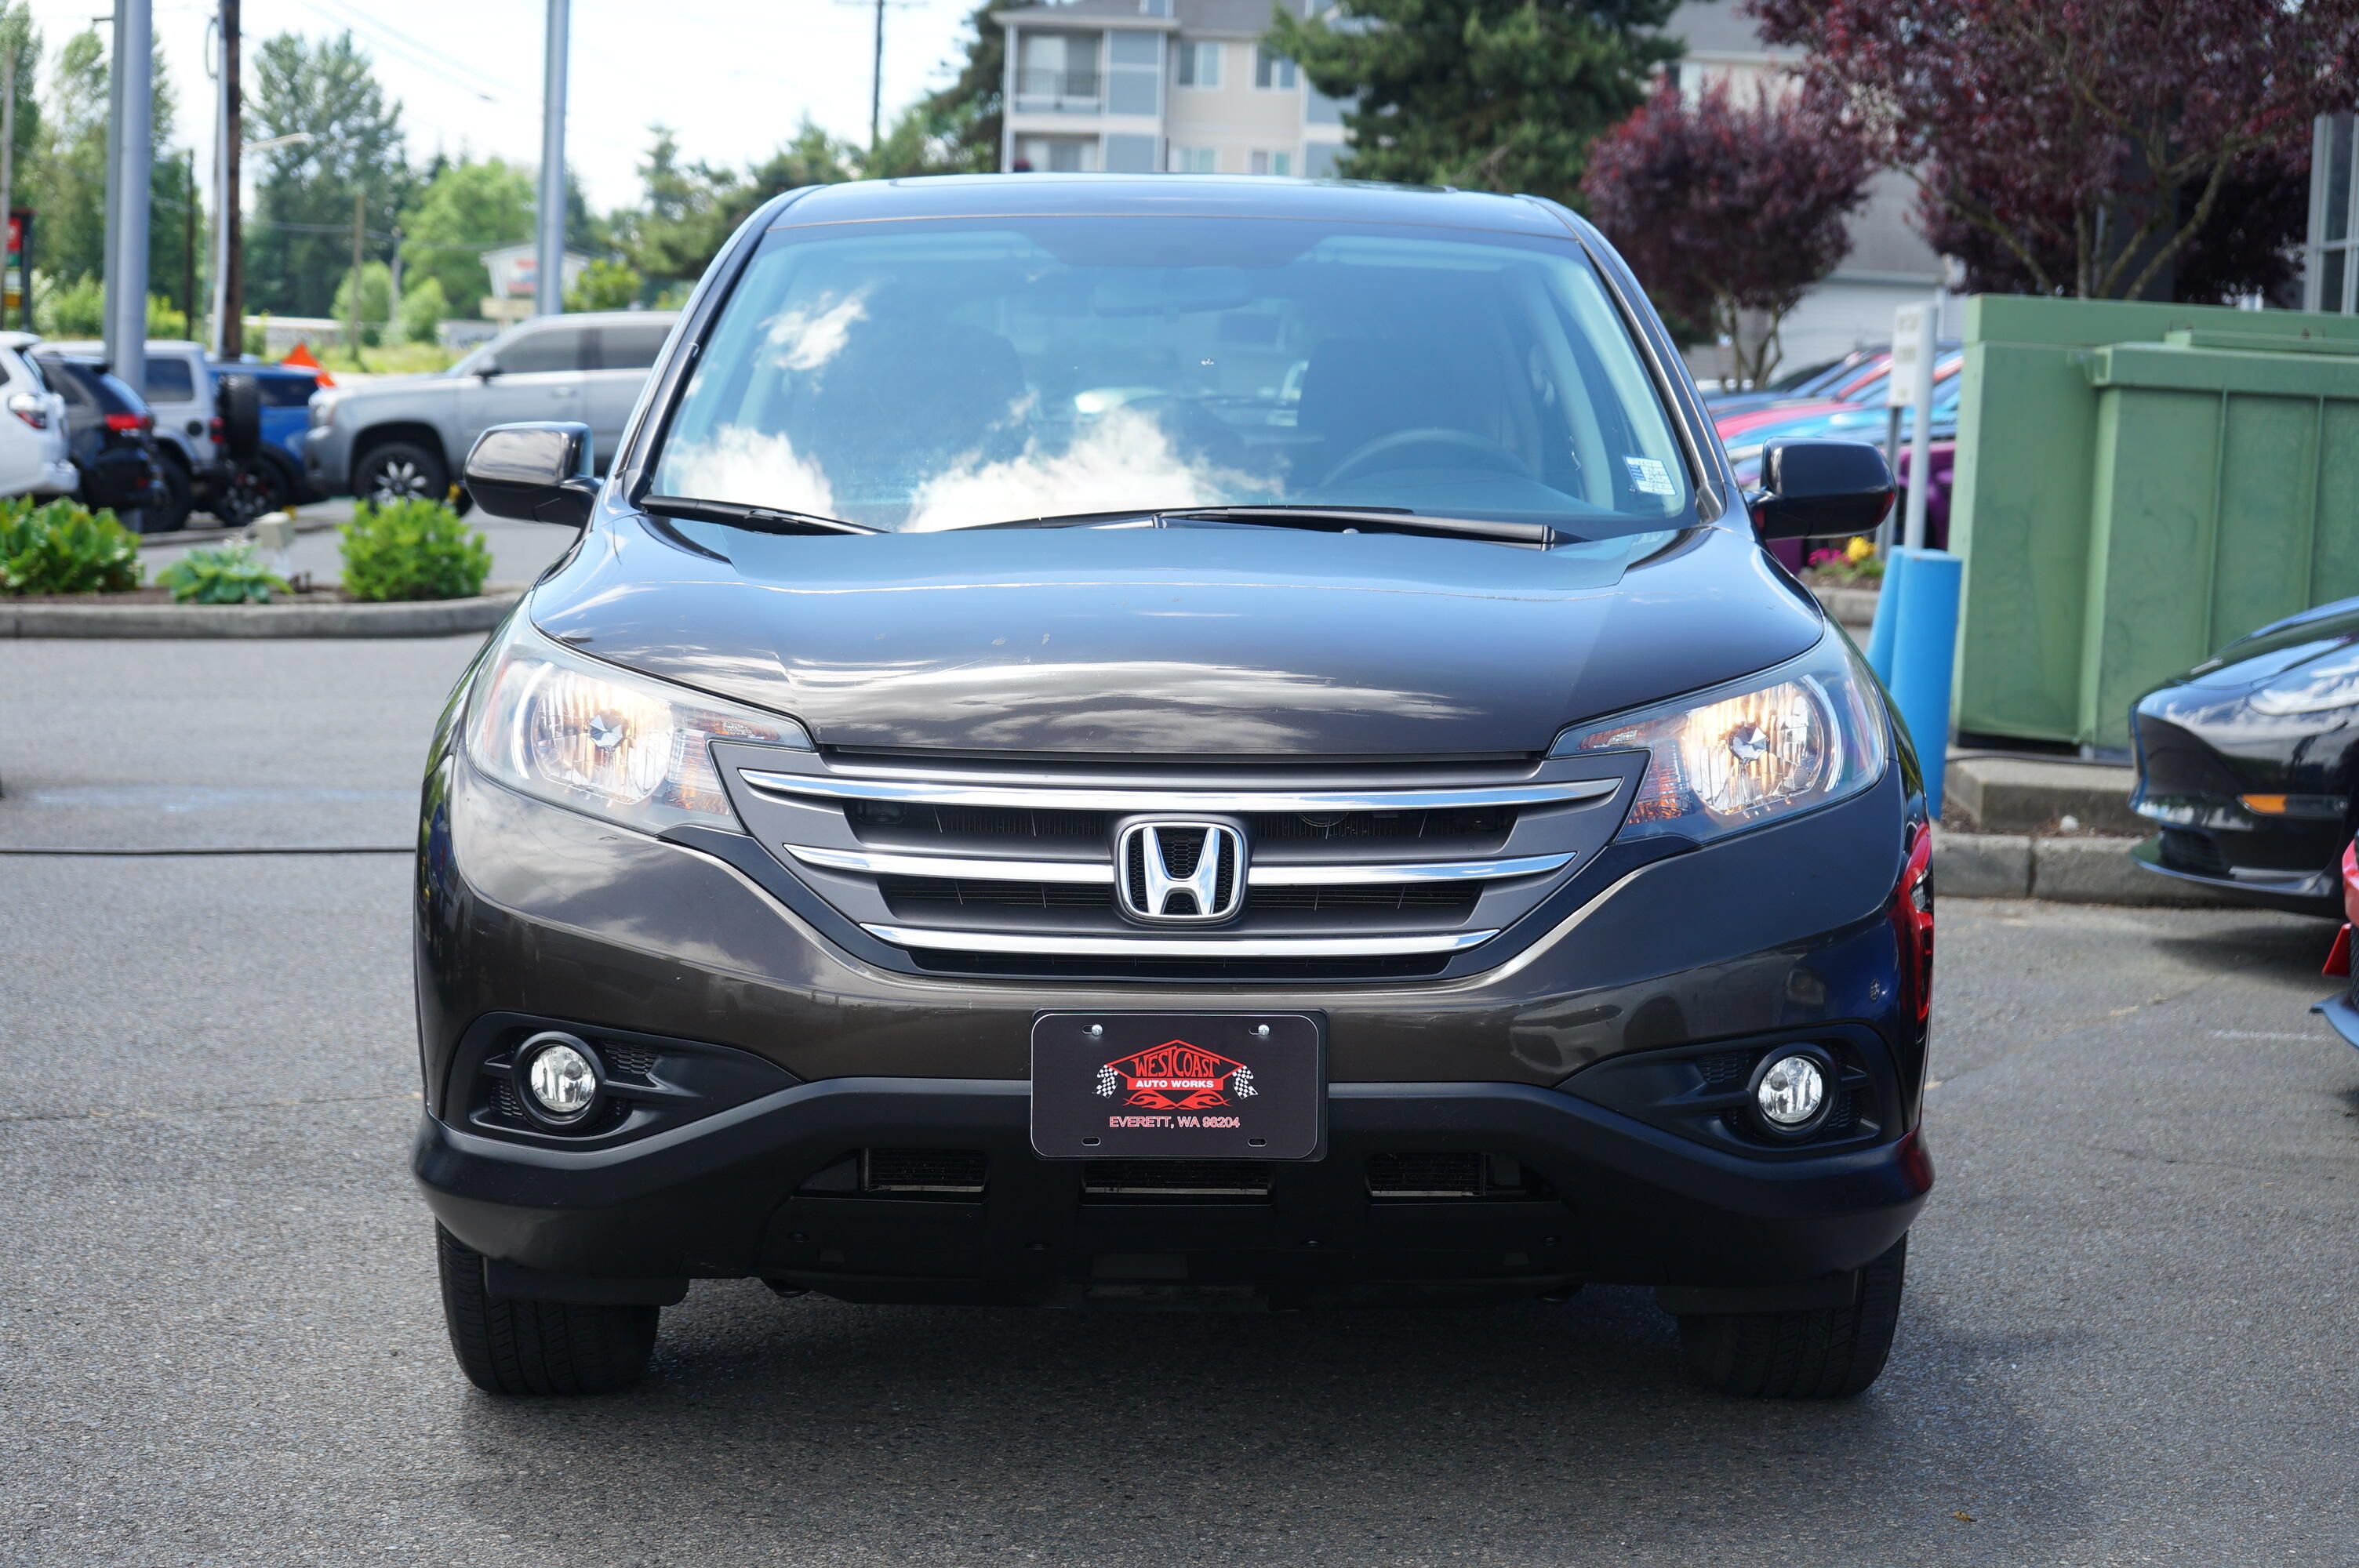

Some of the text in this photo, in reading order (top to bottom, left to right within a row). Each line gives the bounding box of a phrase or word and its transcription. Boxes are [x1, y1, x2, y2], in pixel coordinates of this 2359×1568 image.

[1135, 1080, 1215, 1088] AUTO WORKS
[1109, 1116, 1241, 1129] EVERETT, WA 98204
